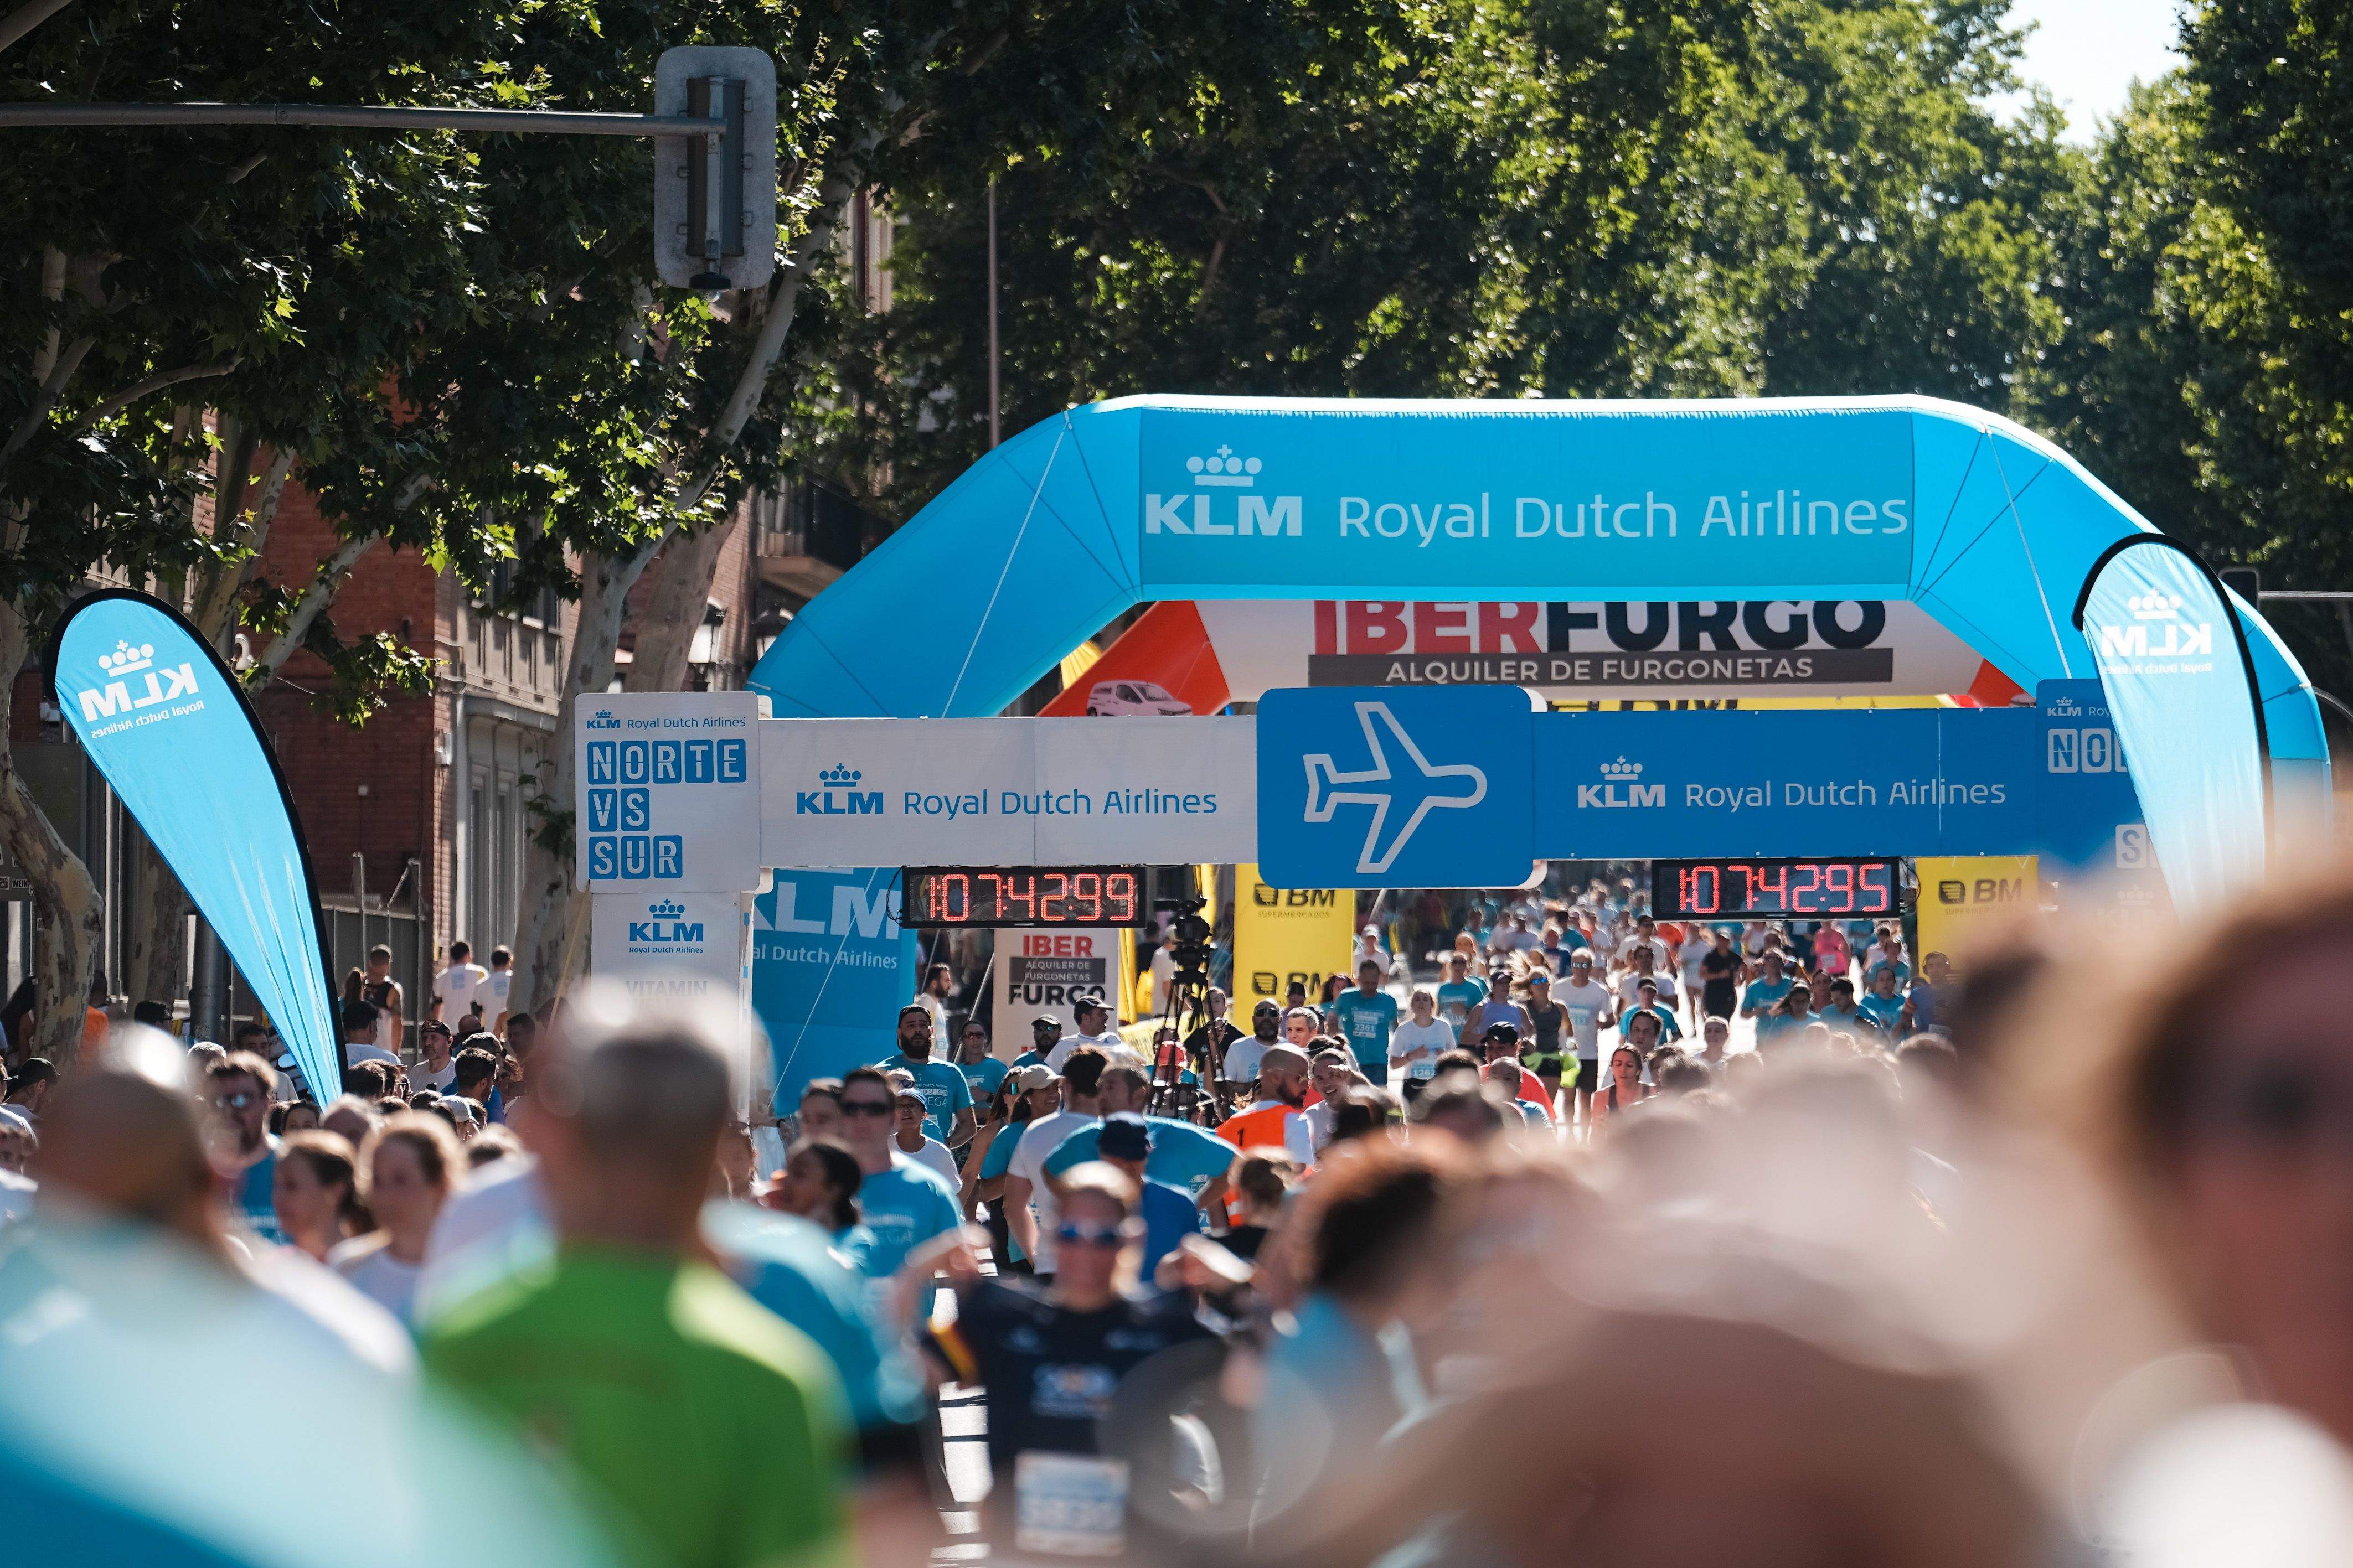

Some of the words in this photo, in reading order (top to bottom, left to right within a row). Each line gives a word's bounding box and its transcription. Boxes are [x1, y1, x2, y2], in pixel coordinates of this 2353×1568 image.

[1145, 493, 1302, 536] KLM
[1340, 491, 1489, 548] Royal
[1515, 491, 1677, 539] Dutch
[1700, 489, 1908, 537] Airlines
[1386, 661, 1539, 684] ALQUILER
[1551, 660, 1590, 682] DE
[1603, 657, 1813, 680] FURGONETAS
[587, 720, 620, 729] KLM
[627, 718, 659, 731] Royal
[664, 717, 698, 728] Dutch
[702, 716, 746, 728] Airlines
[2047, 707, 2082, 717] KLM
[2088, 707, 2111, 718] Roy
[592, 744, 740, 780] NORTE
[797, 791, 884, 815] KLM
[904, 789, 988, 820] Royal
[1001, 788, 1091, 815] Dutch
[1103, 788, 1217, 814] Airlines
[1577, 784, 1666, 808] KLM
[1686, 780, 1771, 813] Royal
[1785, 779, 1876, 806] Dutch
[1888, 779, 2006, 805] Airlines
[594, 793, 645, 827] VS
[594, 839, 678, 876] SUR
[1973, 877, 2022, 904] BM
[1258, 911, 1330, 919] SUPERMERCADOS
[629, 923, 704, 942] KLM
[773, 946, 829, 964] Dutch
[836, 950, 897, 969] Airlines
[1023, 935, 1093, 958] IBER
[1025, 961, 1075, 970] ALQUILER
[1077, 961, 1090, 970] DE
[1025, 972, 1091, 982] FURGONETAS
[625, 980, 708, 996] VITAMIN
[927, 1096, 947, 1107] EGA
[1237, 1128, 1245, 1146] 1
